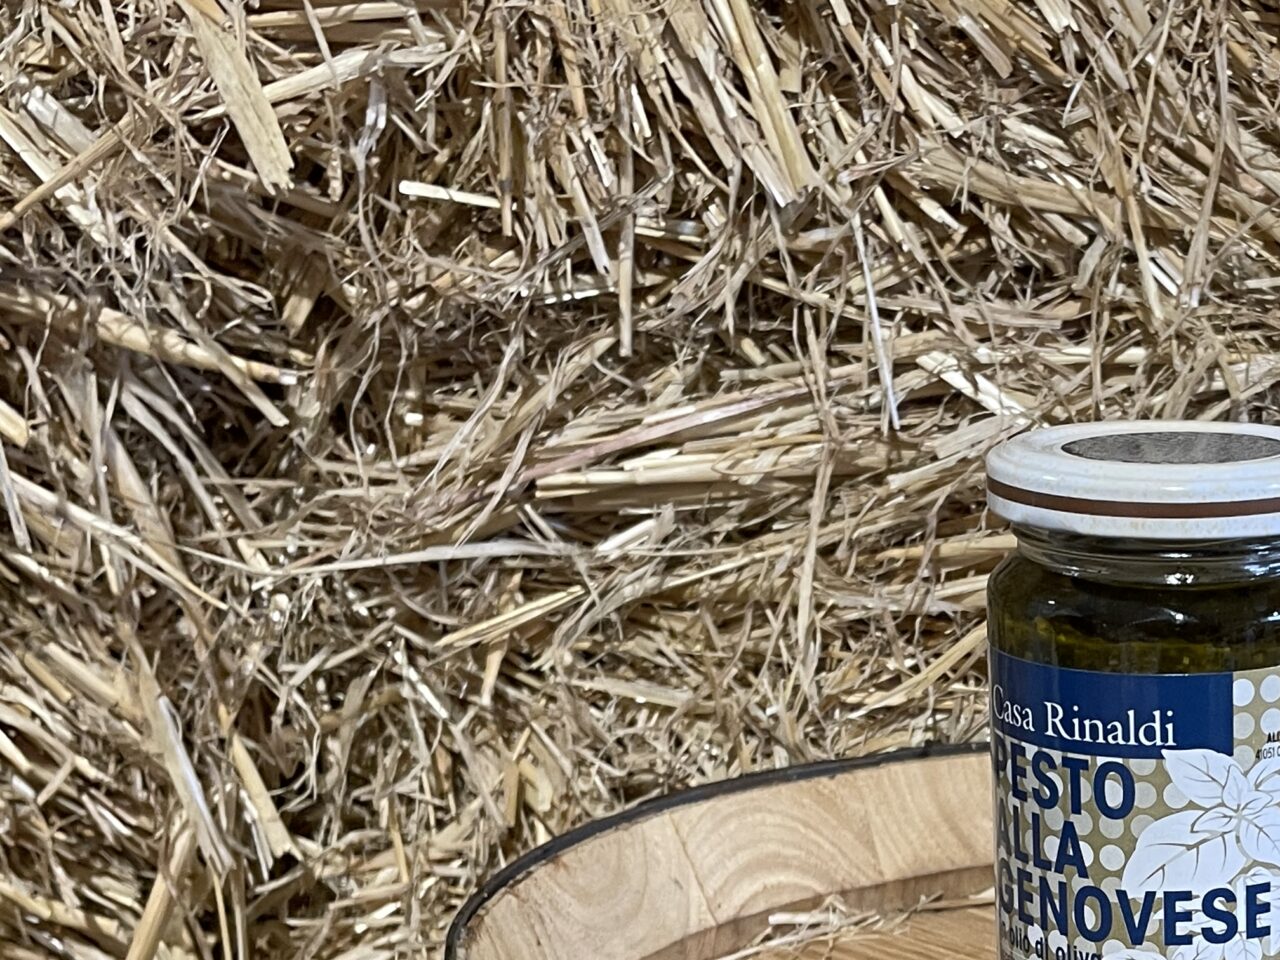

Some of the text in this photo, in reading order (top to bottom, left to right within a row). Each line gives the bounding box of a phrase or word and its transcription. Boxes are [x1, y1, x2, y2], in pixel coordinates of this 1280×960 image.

[993, 684, 1177, 746] Casa Rinaldi
[994, 731, 1136, 820] PESTO
[997, 797, 1089, 879] ALLA
[1000, 857, 1271, 946] GENOVESE
[1009, 926, 1030, 953] olio
[1035, 937, 1048, 960] di
